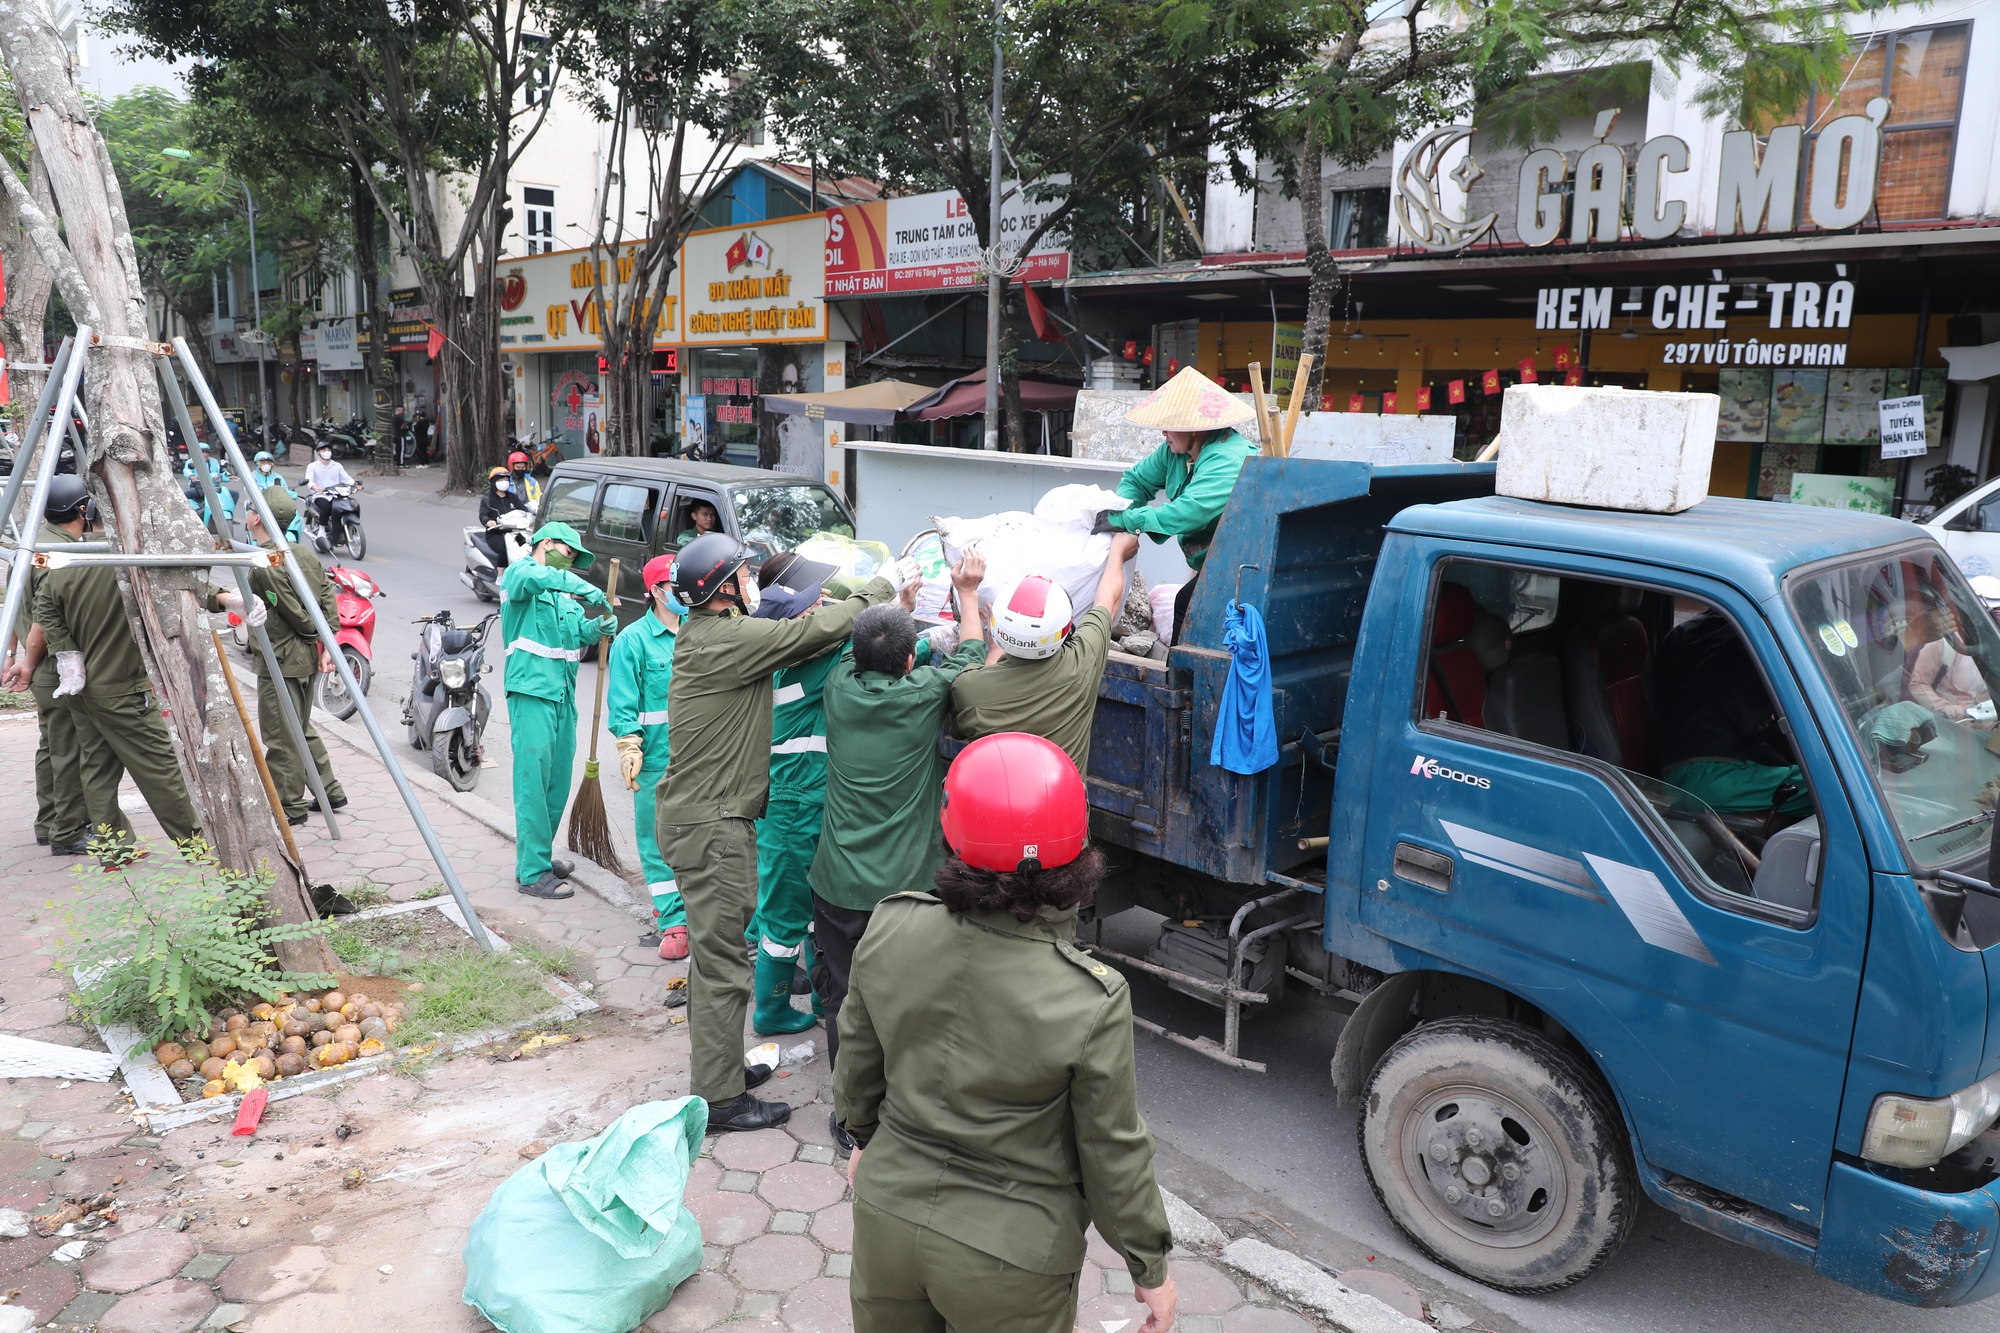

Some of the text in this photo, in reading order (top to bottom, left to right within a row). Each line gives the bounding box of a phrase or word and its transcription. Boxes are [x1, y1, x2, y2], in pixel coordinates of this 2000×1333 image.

[1515, 97, 1892, 247] GÁC MƠ
[895, 228, 929, 245] TRUNG
[933, 224, 955, 240] TÂM
[958, 221, 978, 237] CH
[1000, 214, 1017, 233] ÓC
[1021, 215, 1036, 230] XE
[825, 248, 844, 267] OIL
[708, 268, 791, 301] ĐO KHÁM MẮT
[835, 276, 861, 294] NHẬT
[863, 274, 884, 290] BẢN
[1535, 287, 1613, 329] KEM
[1651, 269, 1730, 329] CHÈ
[1766, 263, 1855, 328] TRÀ
[547, 304, 567, 339] QT
[690, 310, 719, 334] CÔNG
[720, 307, 751, 336] NGHỆ
[753, 305, 784, 335] NHẬT
[787, 301, 816, 328] BẢN
[1663, 338, 1848, 365] 297 VŨ TÔNG PHAN
[702, 378, 712, 394] ĐO
[714, 374, 737, 396] KHÁM
[1902, 400, 1921, 408] Coffee
[1883, 429, 1924, 444] NHÂN VIÊN
[997, 627, 1037, 648] HDBank
